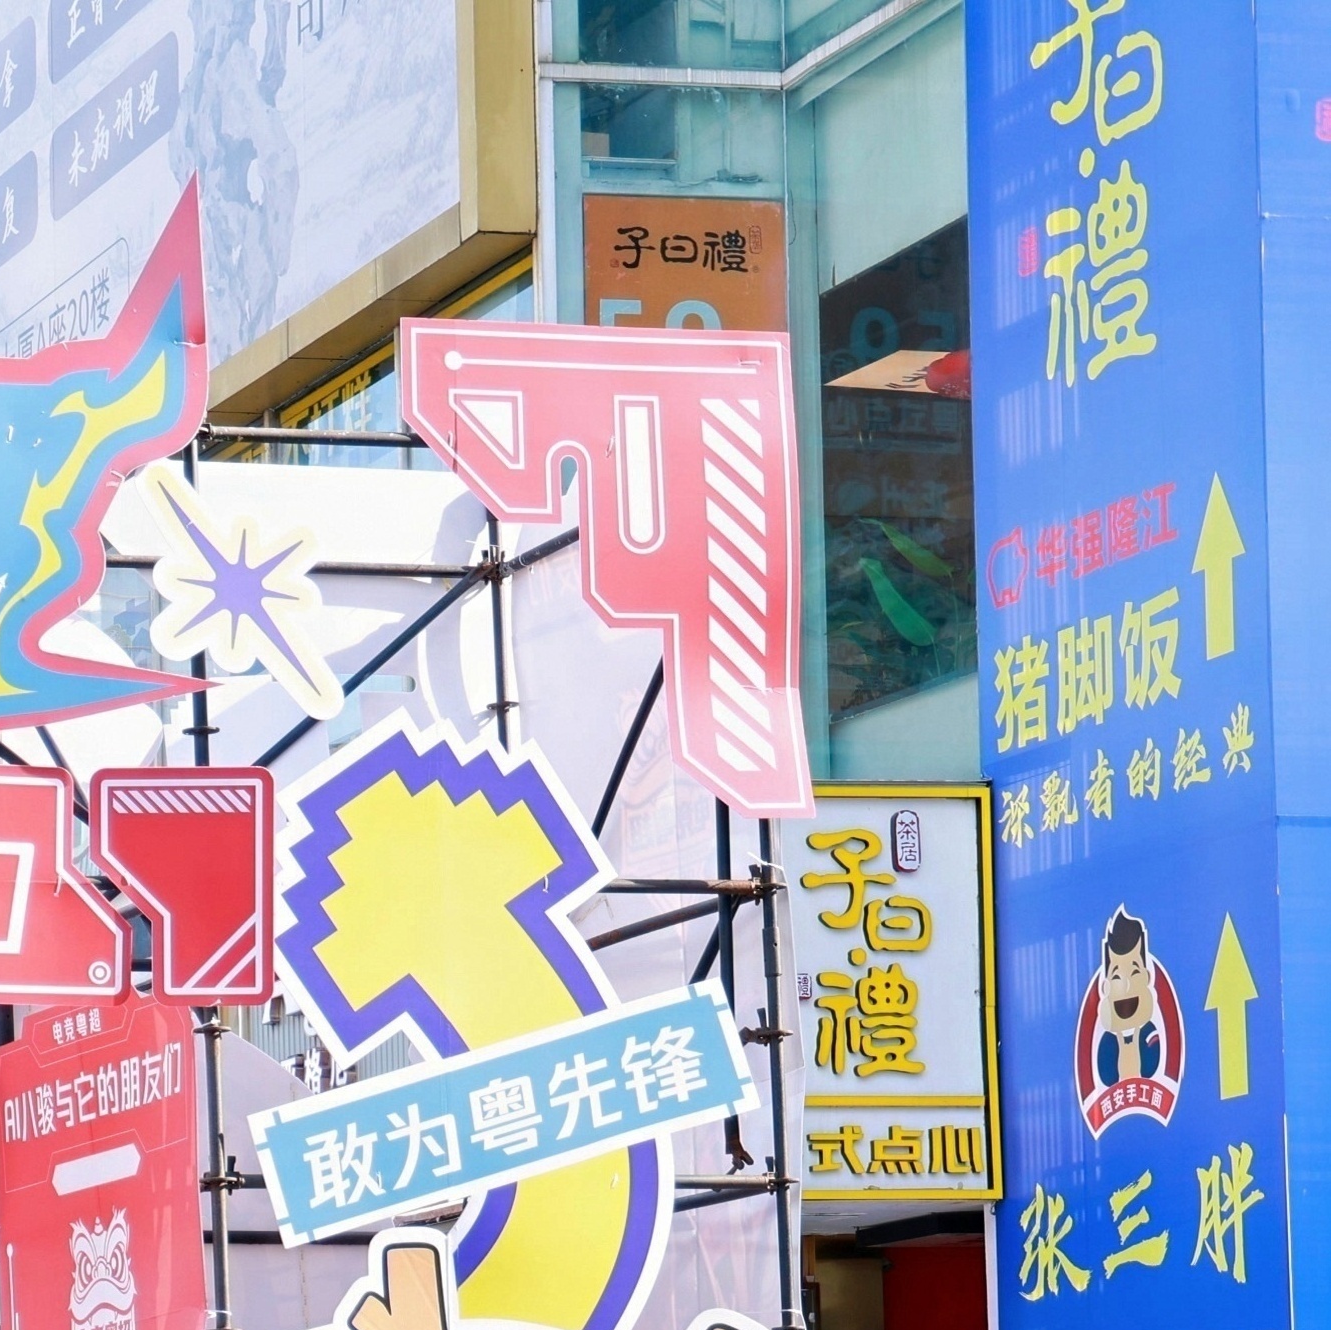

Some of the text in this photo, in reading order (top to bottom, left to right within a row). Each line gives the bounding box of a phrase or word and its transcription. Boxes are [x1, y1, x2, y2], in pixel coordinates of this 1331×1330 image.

[67, 69, 160, 187] 未病调理
[1037, 482, 1178, 587] 华强隆江
[994, 587, 1182, 753] 猪脚饭
[52, 1008, 102, 1045] 电竞粤超
[4, 1041, 182, 1143] AI八骏与它的朋友们
[302, 1025, 708, 1208] 敢为粤先锋
[1101, 1084, 1164, 1119] 西安手工面
[1019, 1142, 1264, 1301] 张三胖
